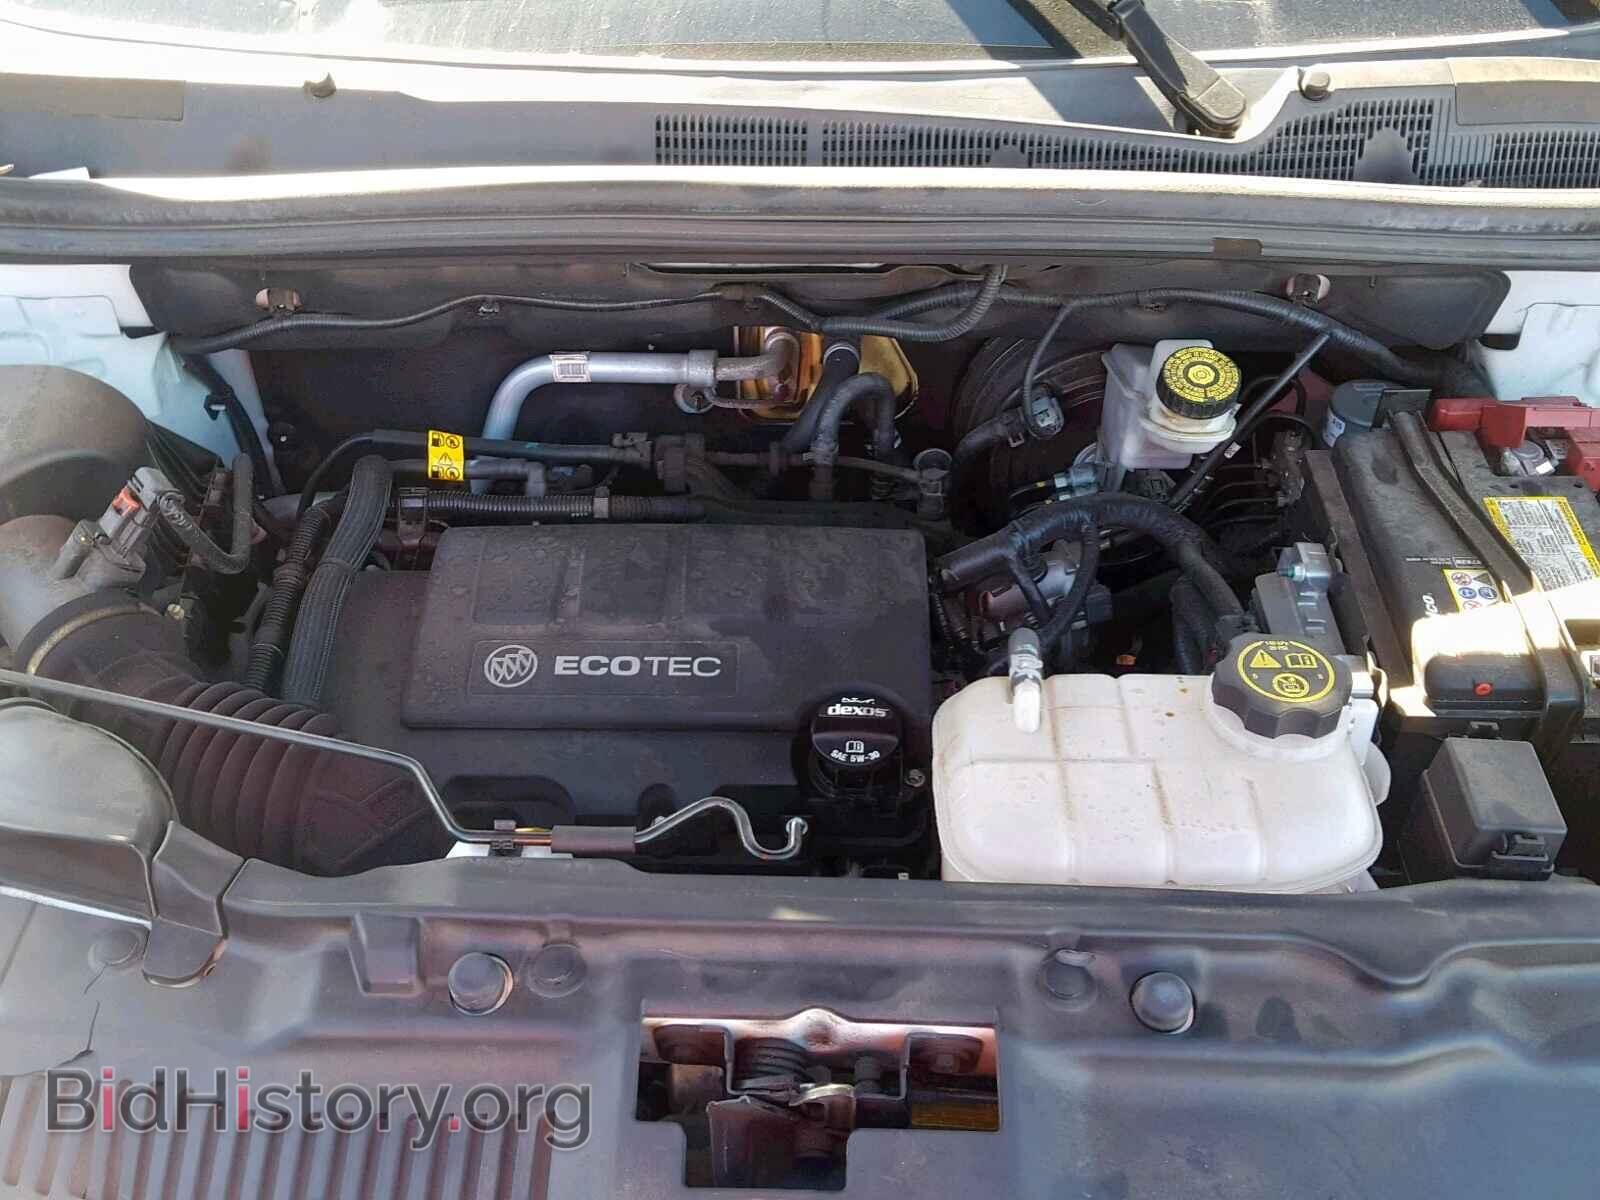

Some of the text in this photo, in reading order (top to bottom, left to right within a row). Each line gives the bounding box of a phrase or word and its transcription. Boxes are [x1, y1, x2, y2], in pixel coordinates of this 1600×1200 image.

[554, 655, 721, 677] ECOTEC
[827, 704, 889, 717] dexos
[830, 749, 848, 762] SAE
